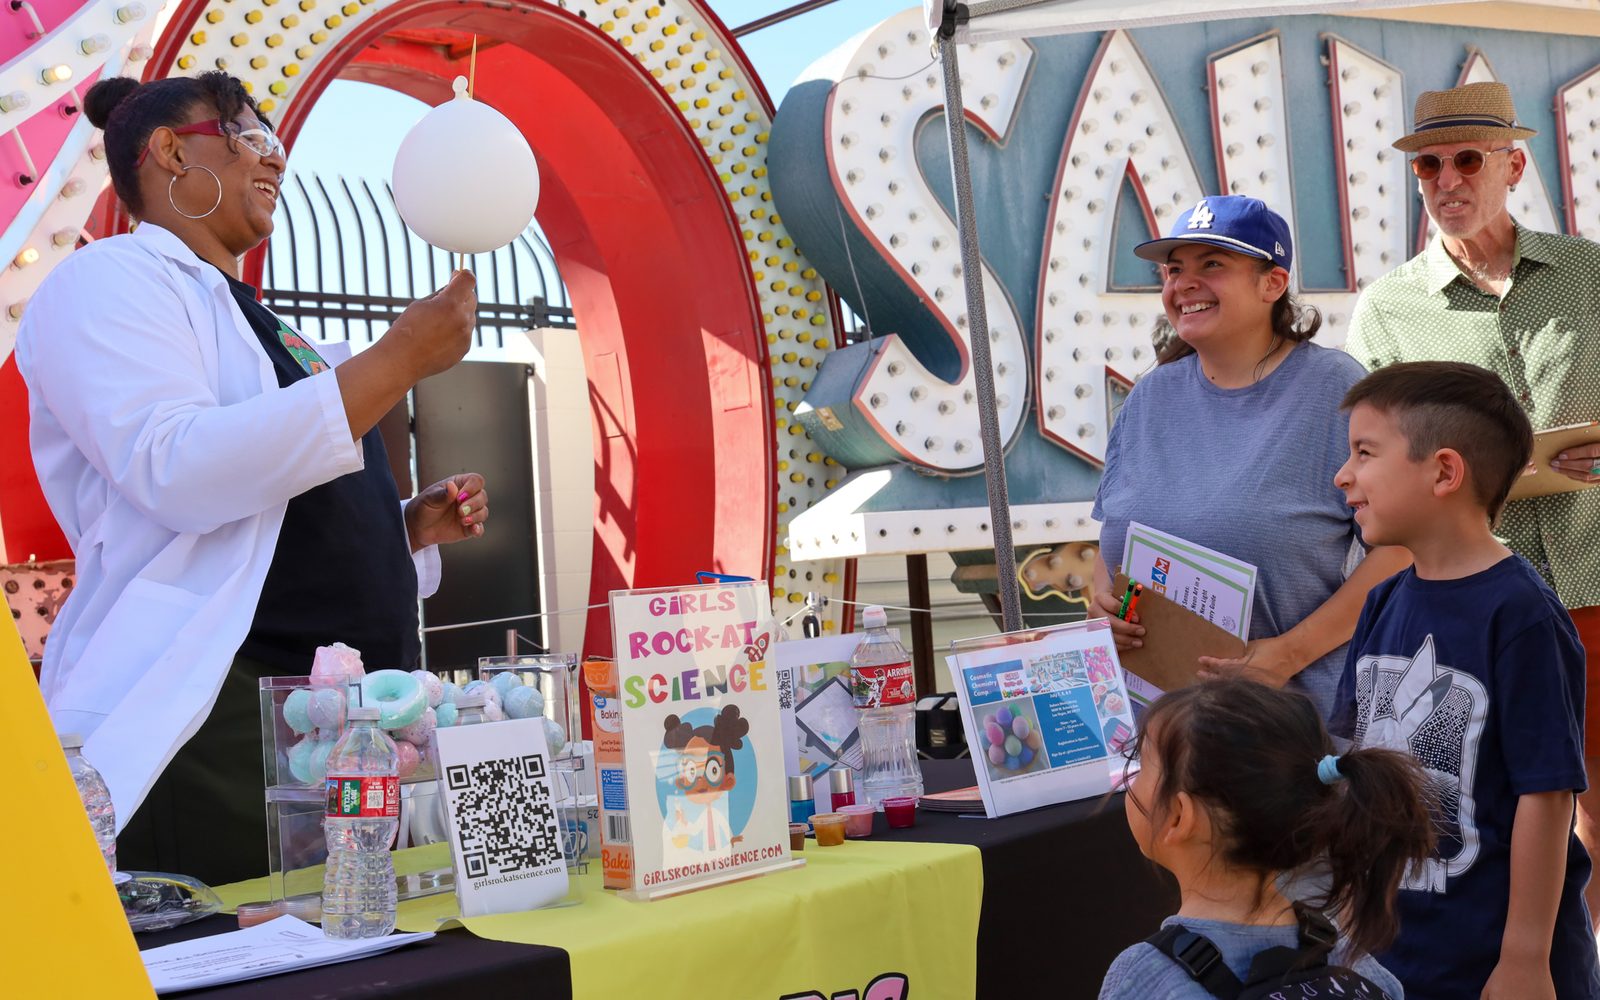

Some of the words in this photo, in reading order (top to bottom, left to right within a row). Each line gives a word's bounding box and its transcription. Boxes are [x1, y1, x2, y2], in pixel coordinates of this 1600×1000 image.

[1188, 200, 1214, 229] LA
[1153, 557, 1170, 594] EAM
[629, 621, 757, 659] ROCK-AT
[624, 661, 767, 708] SCIENCE
[343, 781, 351, 813] RECYCLED
[601, 848, 632, 870] Baki
[473, 866, 562, 891] girlsrockatscience.com
